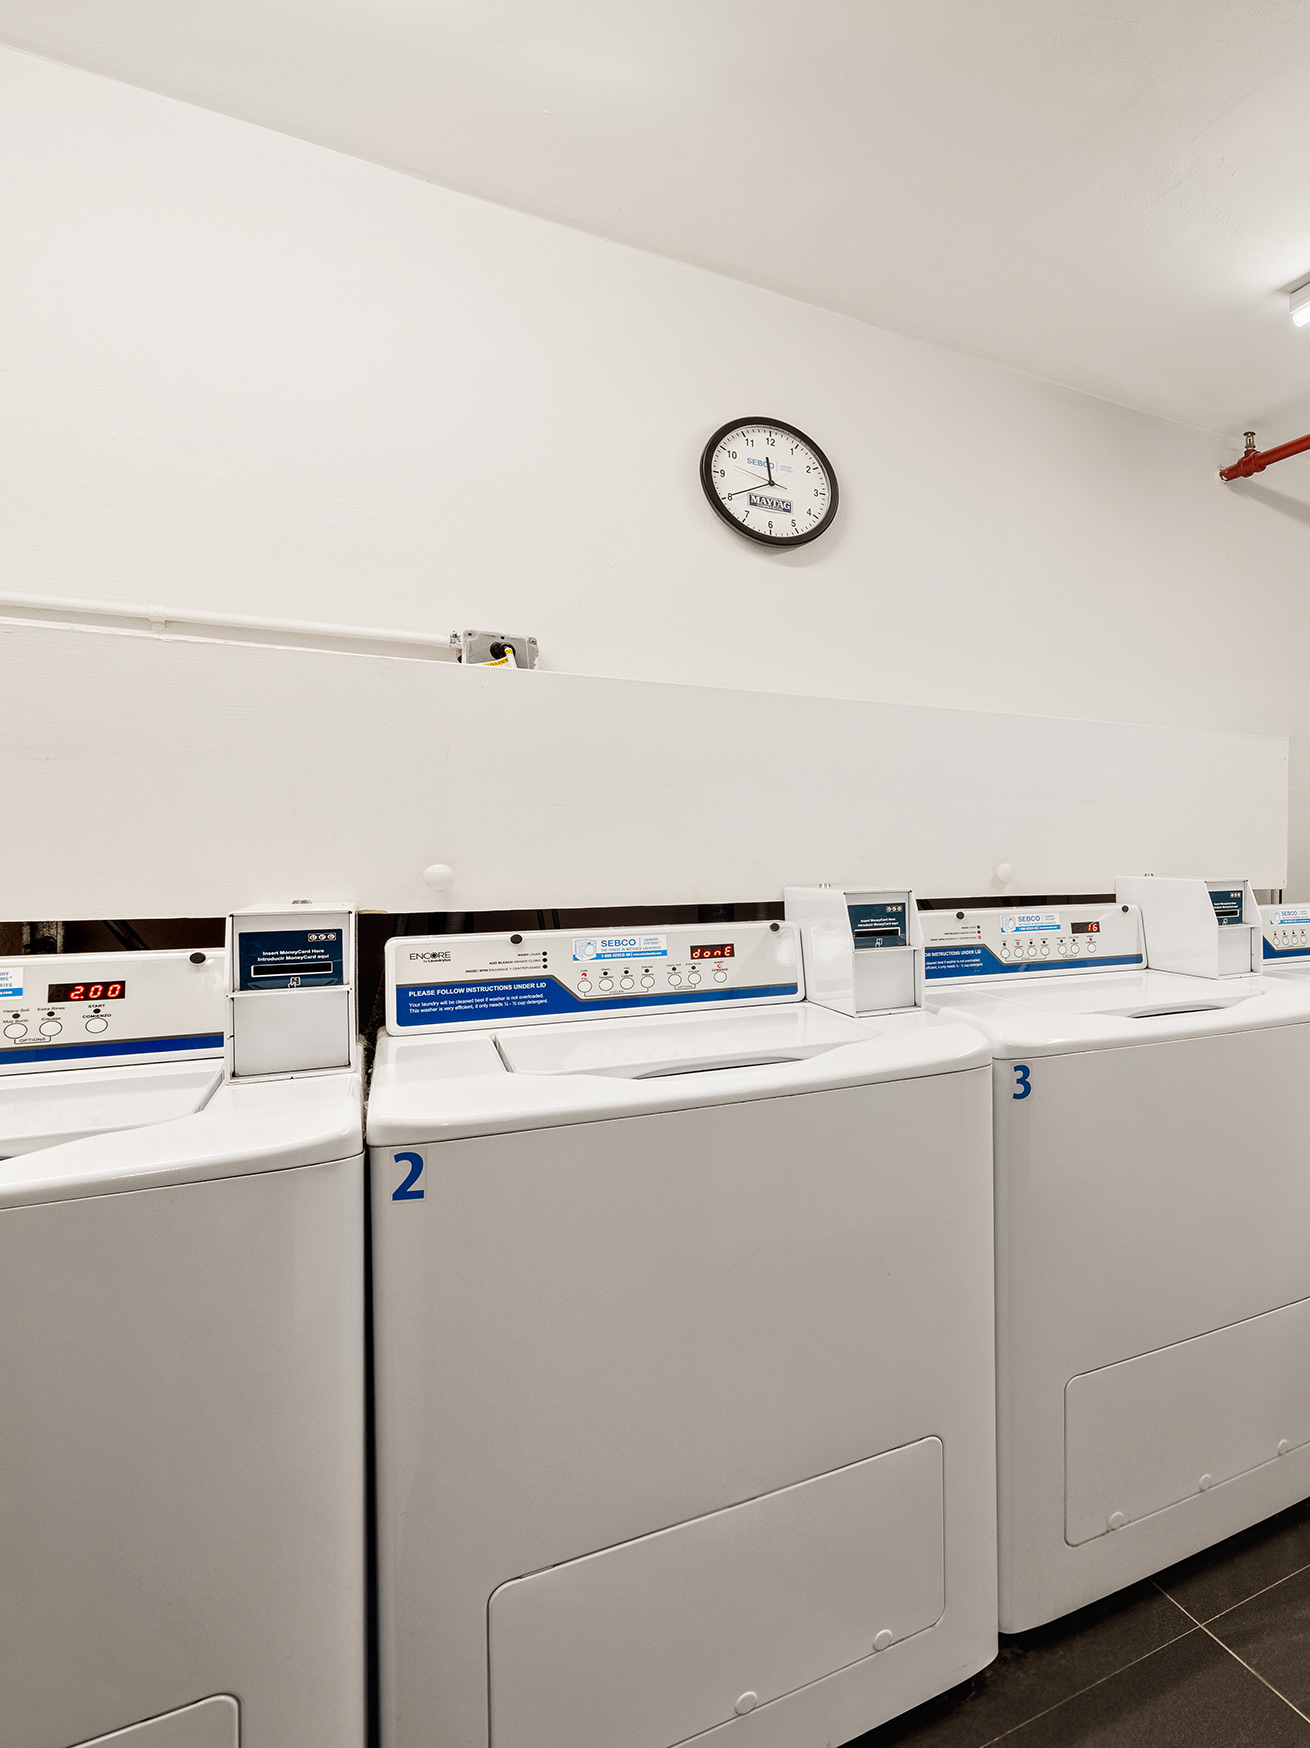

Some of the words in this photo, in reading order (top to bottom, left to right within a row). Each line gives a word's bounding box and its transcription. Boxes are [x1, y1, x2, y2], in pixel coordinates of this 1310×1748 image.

[745, 438, 754, 447] 11
[766, 437, 776, 446] 12
[727, 450, 737, 459] 10
[746, 458, 775, 469] SEBCO
[751, 495, 791, 509] MAYTAG
[1087, 923, 1098, 932] 16
[601, 939, 636, 947] SEBCO
[410, 951, 451, 960] ENCORE
[70, 984, 121, 999] 2.00
[466, 984, 512, 993] INSTRUCTIONS
[1012, 1064, 1031, 1099] 3
[392, 1151, 424, 1201] 2
